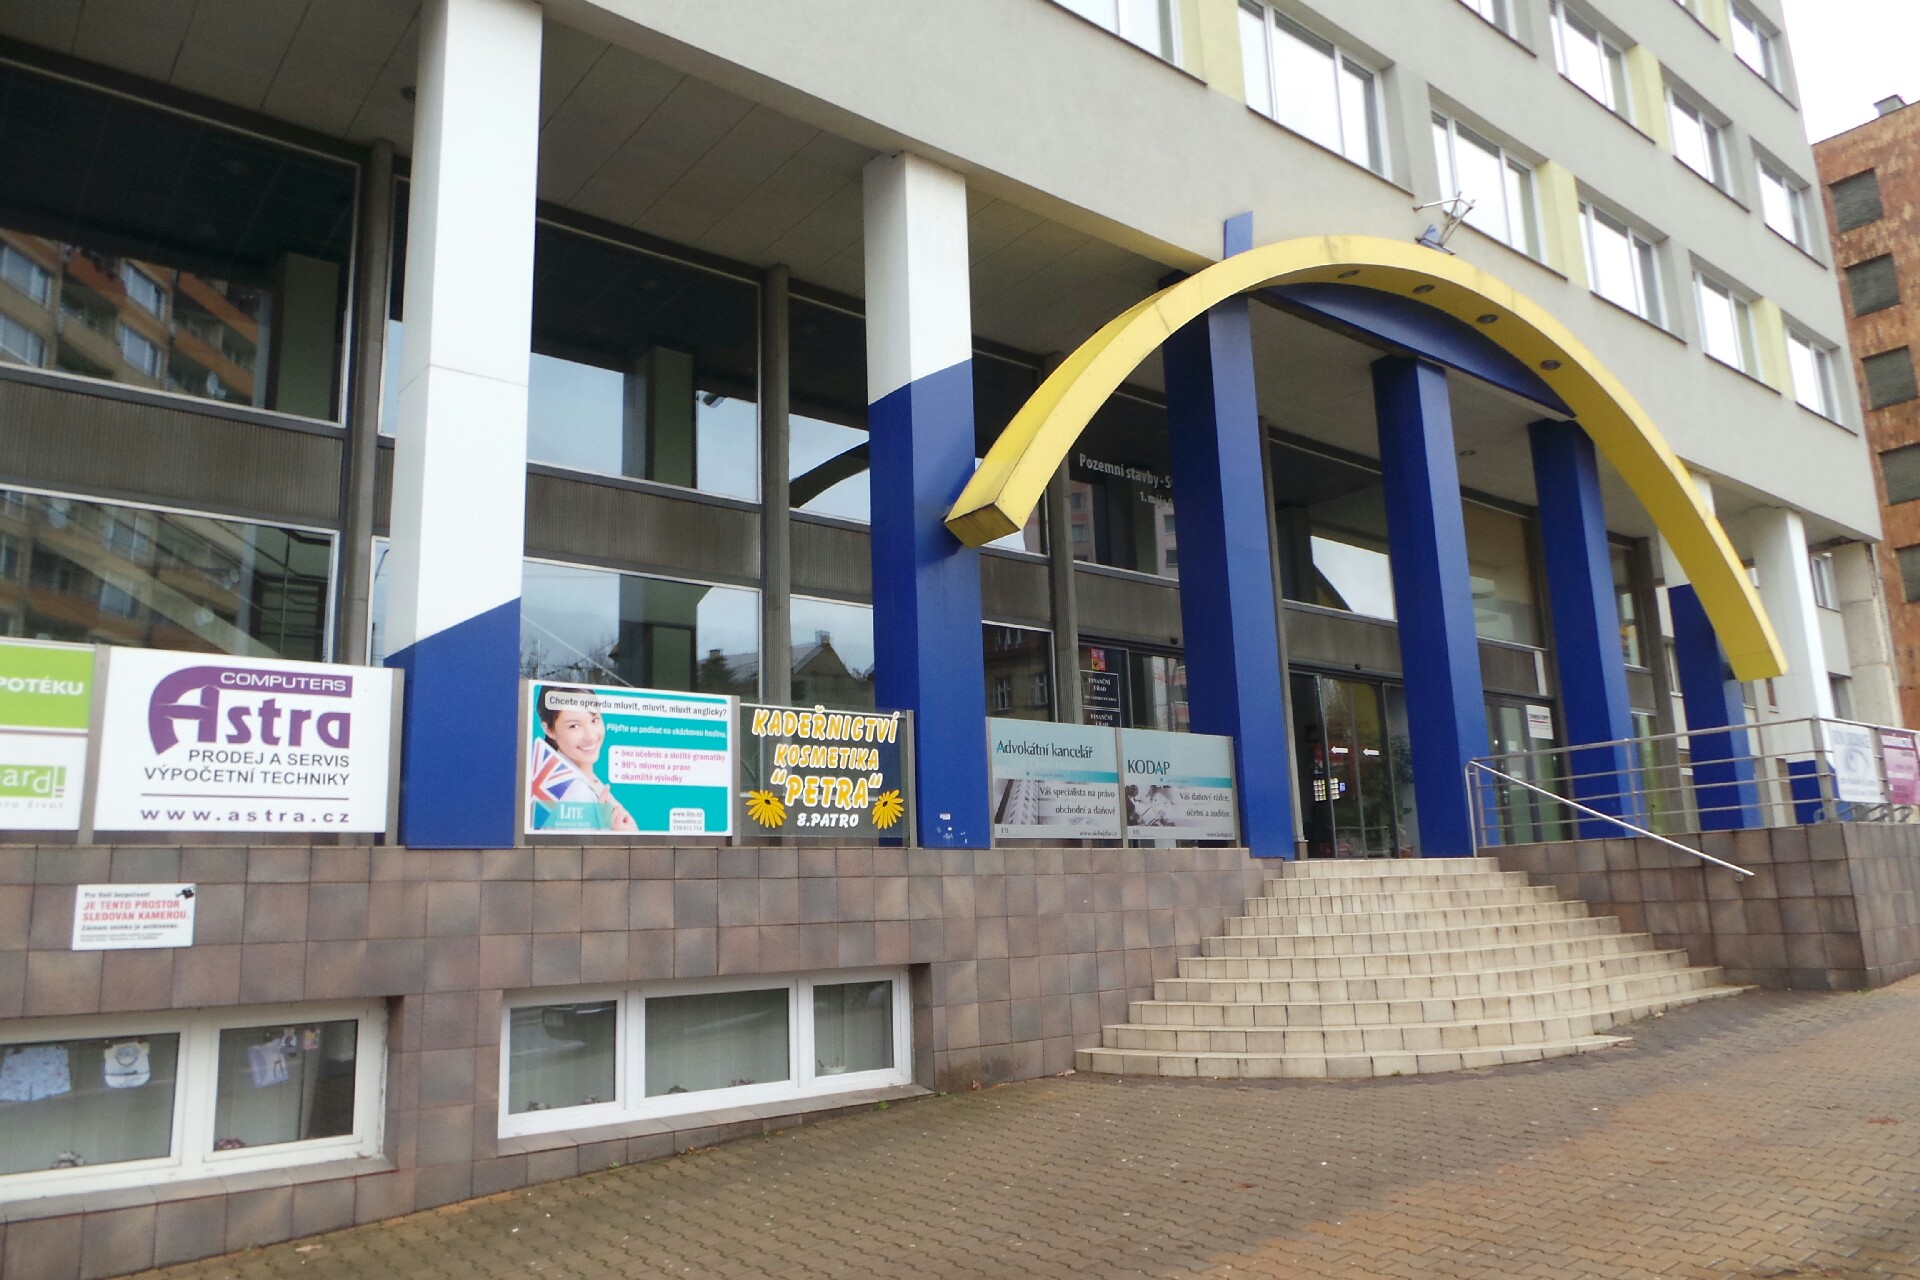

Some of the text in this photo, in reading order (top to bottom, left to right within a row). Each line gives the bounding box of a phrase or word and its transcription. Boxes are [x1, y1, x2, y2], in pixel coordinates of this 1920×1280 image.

[1079, 453, 1125, 477] Pozemní
[1126, 467, 1159, 489] stavby
[1165, 475, 1173, 488] S
[1139, 491, 1147, 502] 1.
[220, 671, 347, 692] COMPUTERS
[148, 666, 351, 755] Astra
[549, 696, 727, 718] Chcete opravdu mluvit, mluvit, mluvit anglicky?
[752, 704, 901, 744] KADEŘNICTVÍ
[621, 749, 634, 757] bez
[635, 750, 663, 759] učebnic
[669, 751, 691, 760] složité
[692, 753, 726, 763] gramatiky
[996, 739, 1094, 759] Advokátní kancelář
[188, 749, 350, 767] PRODEJ A SERVIS
[773, 743, 879, 772] KOSMETIKA
[144, 763, 350, 787] VÝPOČETNÍ TECHNIKY
[1127, 759, 1170, 775] KODAP
[621, 773, 683, 784] okamžité výsledky
[1039, 786, 1052, 796] Váš
[1053, 787, 1086, 799] specialista
[1097, 789, 1115, 800] právo
[1179, 792, 1190, 800] Váš
[1191, 793, 1212, 803] daňový
[140, 809, 350, 823] www.astra.cz
[560, 803, 584, 820] LITE
[1055, 804, 1087, 814] obchodní
[1093, 805, 1116, 815] daňové
[1186, 808, 1205, 817] účetní
[796, 812, 860, 829] 8.PATRO
[83, 900, 181, 911] JE TENTO PROSTOR
[138, 910, 190, 921] KAMEROU.
